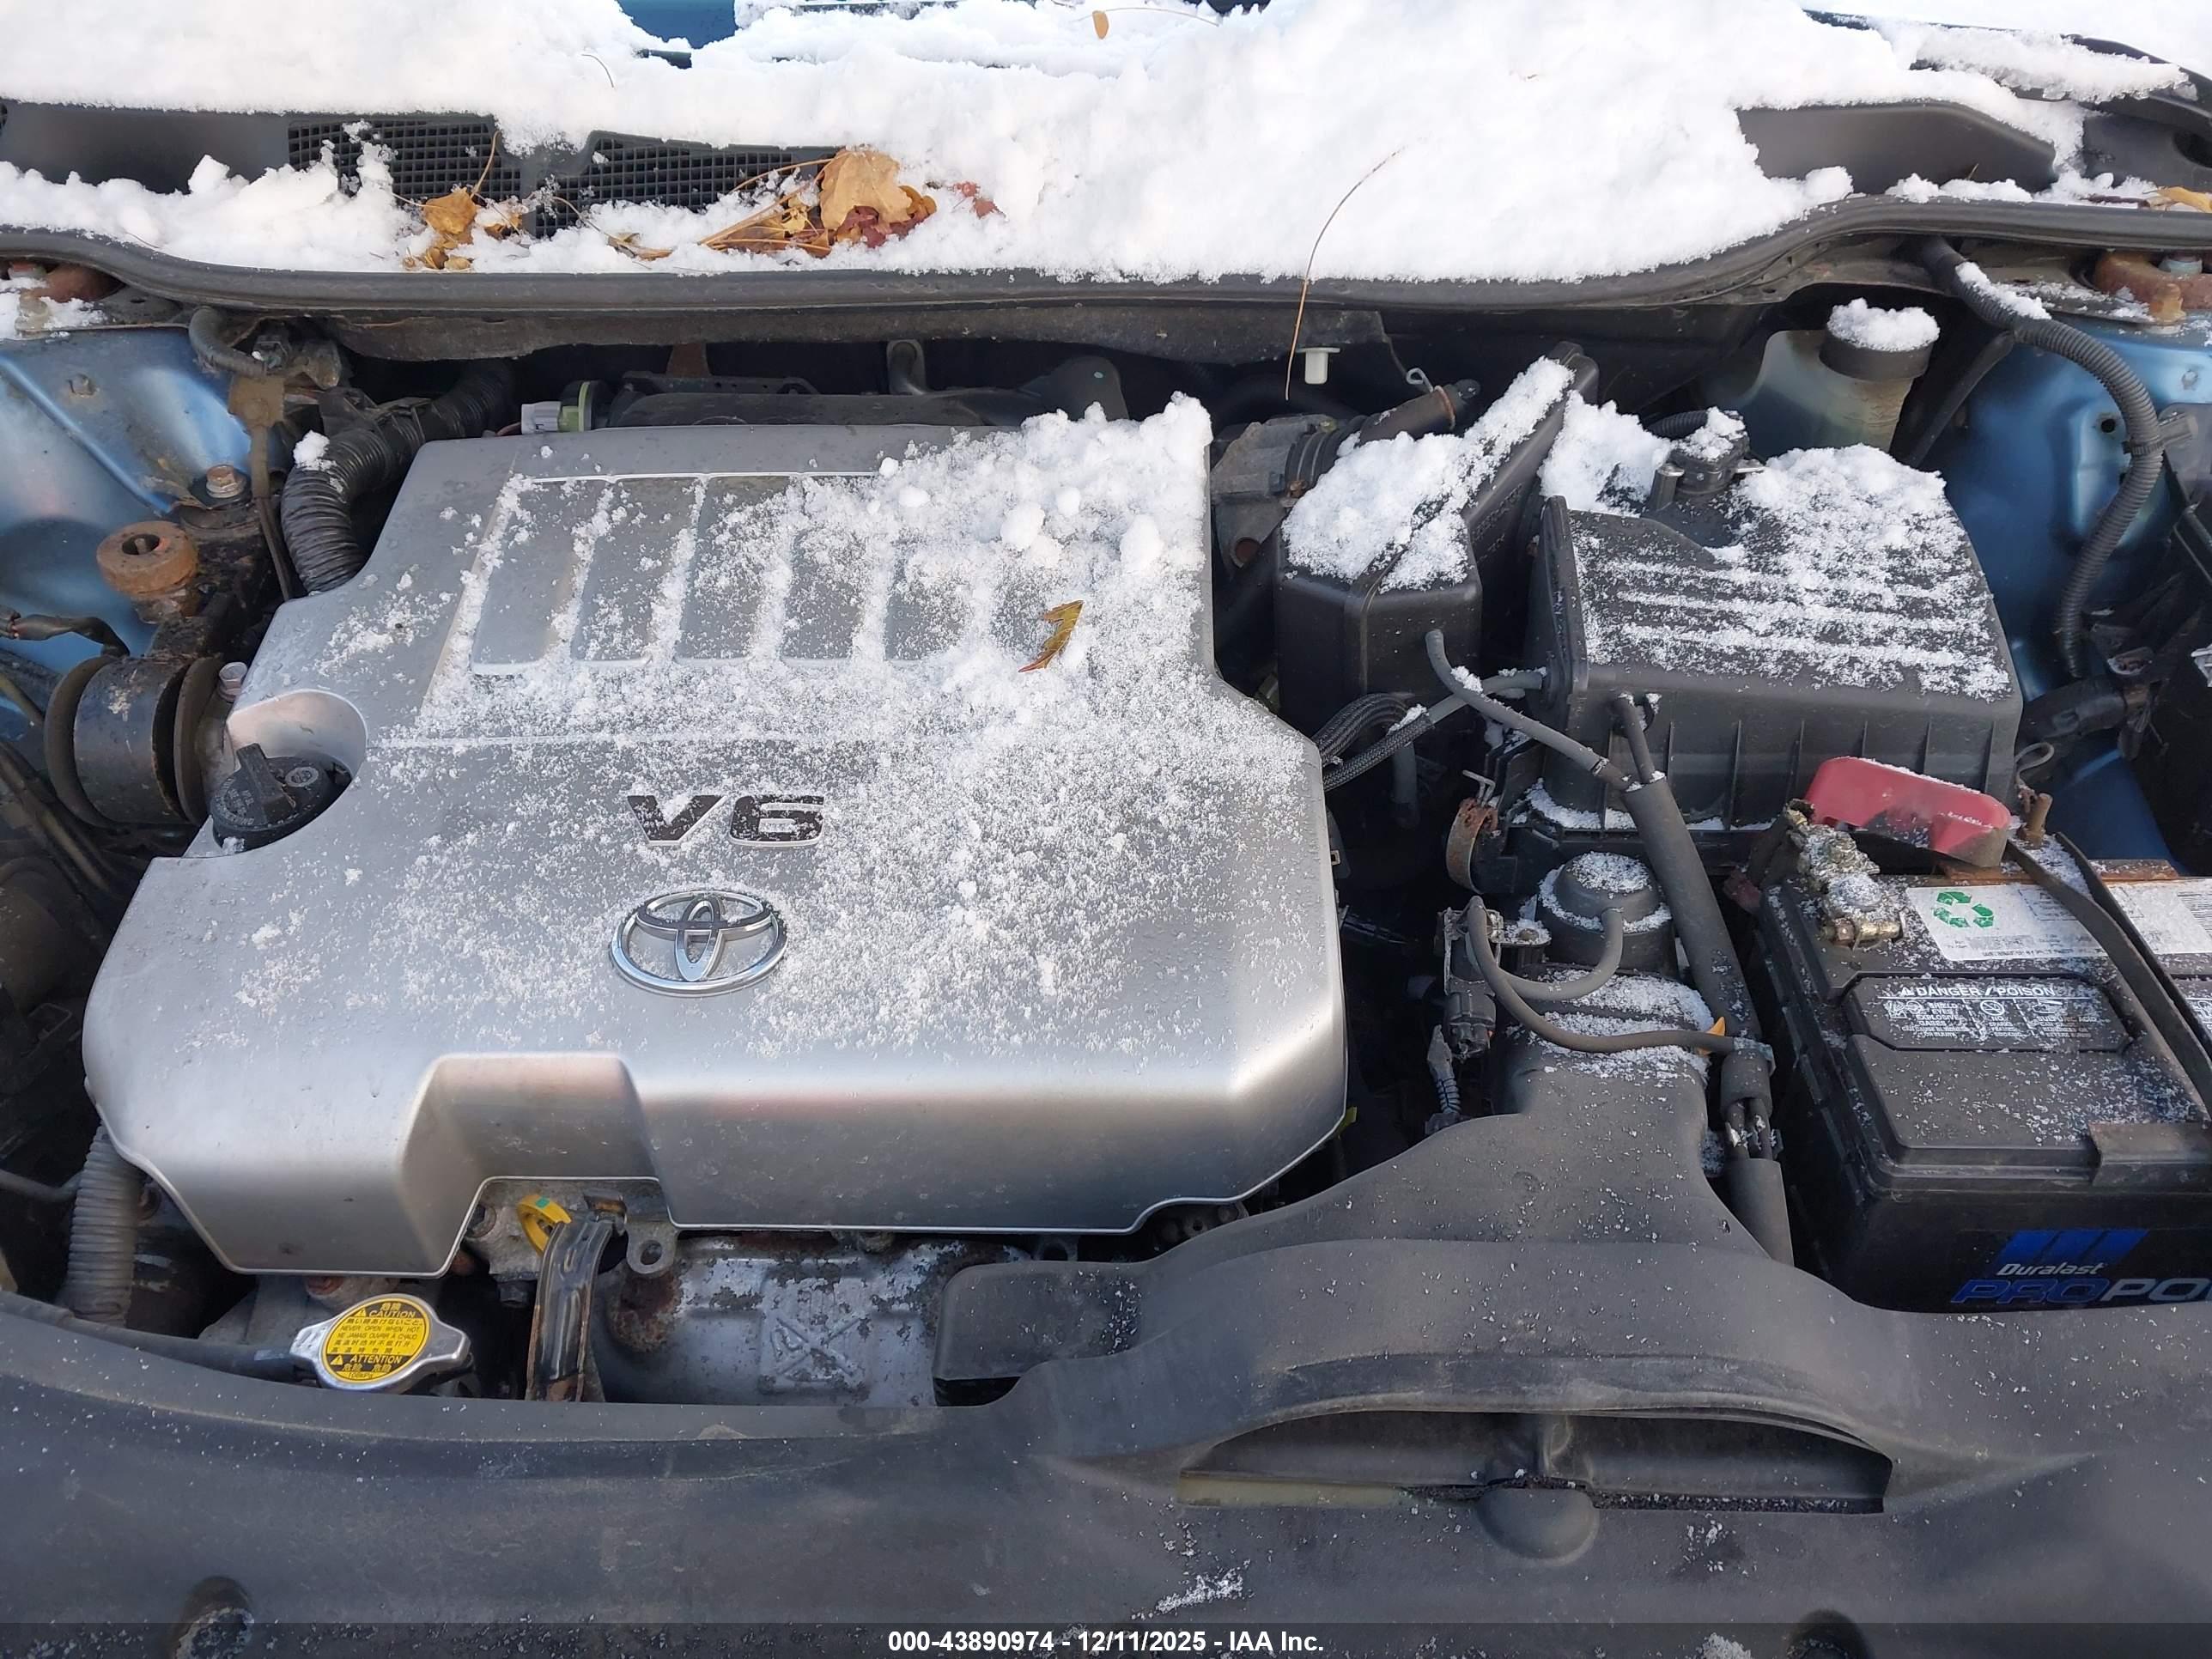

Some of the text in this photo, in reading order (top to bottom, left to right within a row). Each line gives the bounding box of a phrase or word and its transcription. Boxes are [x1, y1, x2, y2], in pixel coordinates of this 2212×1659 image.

[627, 794, 825, 847] V6
[1917, 987, 1980, 996] DANGER
[1997, 987, 2055, 996] POISON
[1996, 1261, 2105, 1277] Duralast
[1950, 1278, 2212, 1304] PROPO
[349, 1354, 403, 1364] ATTENTION
